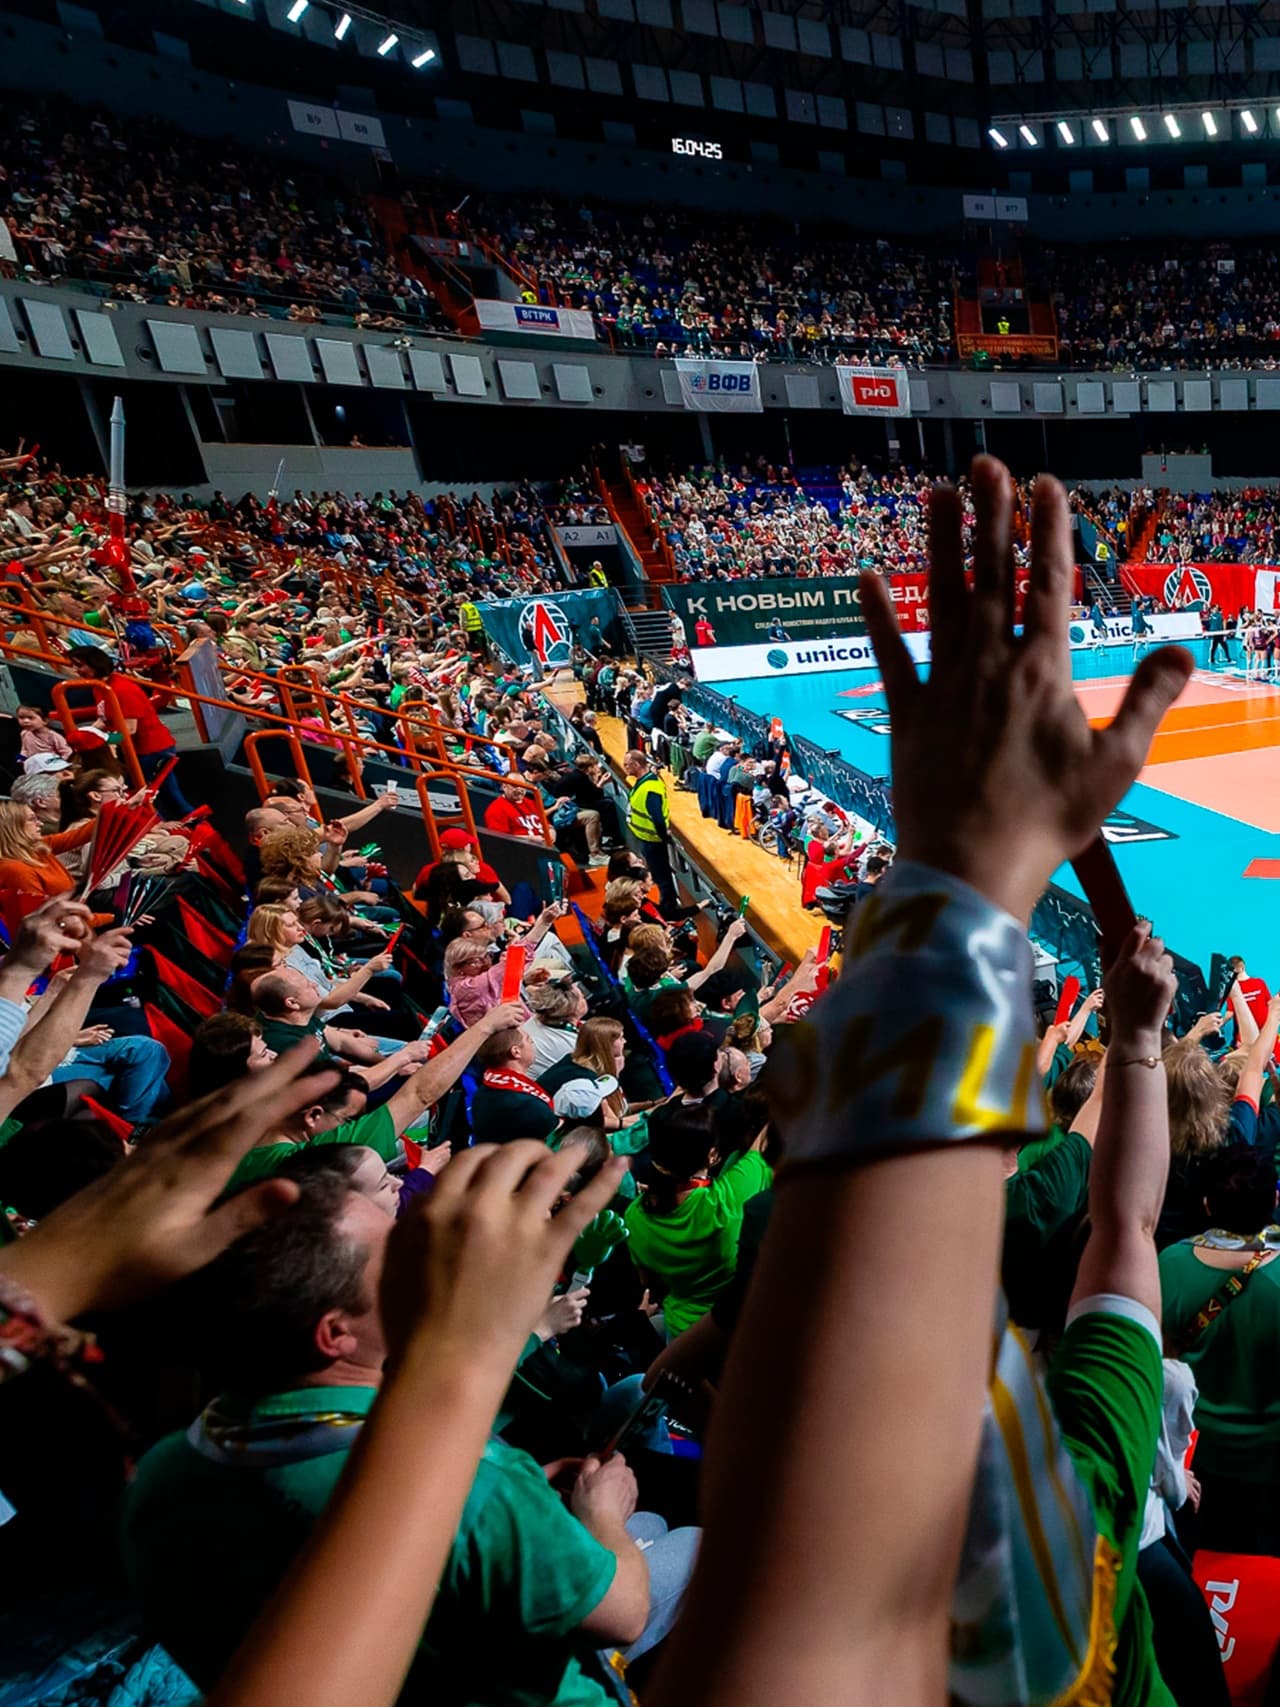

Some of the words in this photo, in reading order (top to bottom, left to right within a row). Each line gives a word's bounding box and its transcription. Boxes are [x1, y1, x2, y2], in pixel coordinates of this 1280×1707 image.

[521, 309, 552, 321] ВГТРК
[708, 373, 750, 391] ВФВ
[564, 531, 579, 541] A2
[596, 531, 609, 540] A1
[687, 597, 708, 614] К
[716, 591, 825, 612] НОВЫМ
